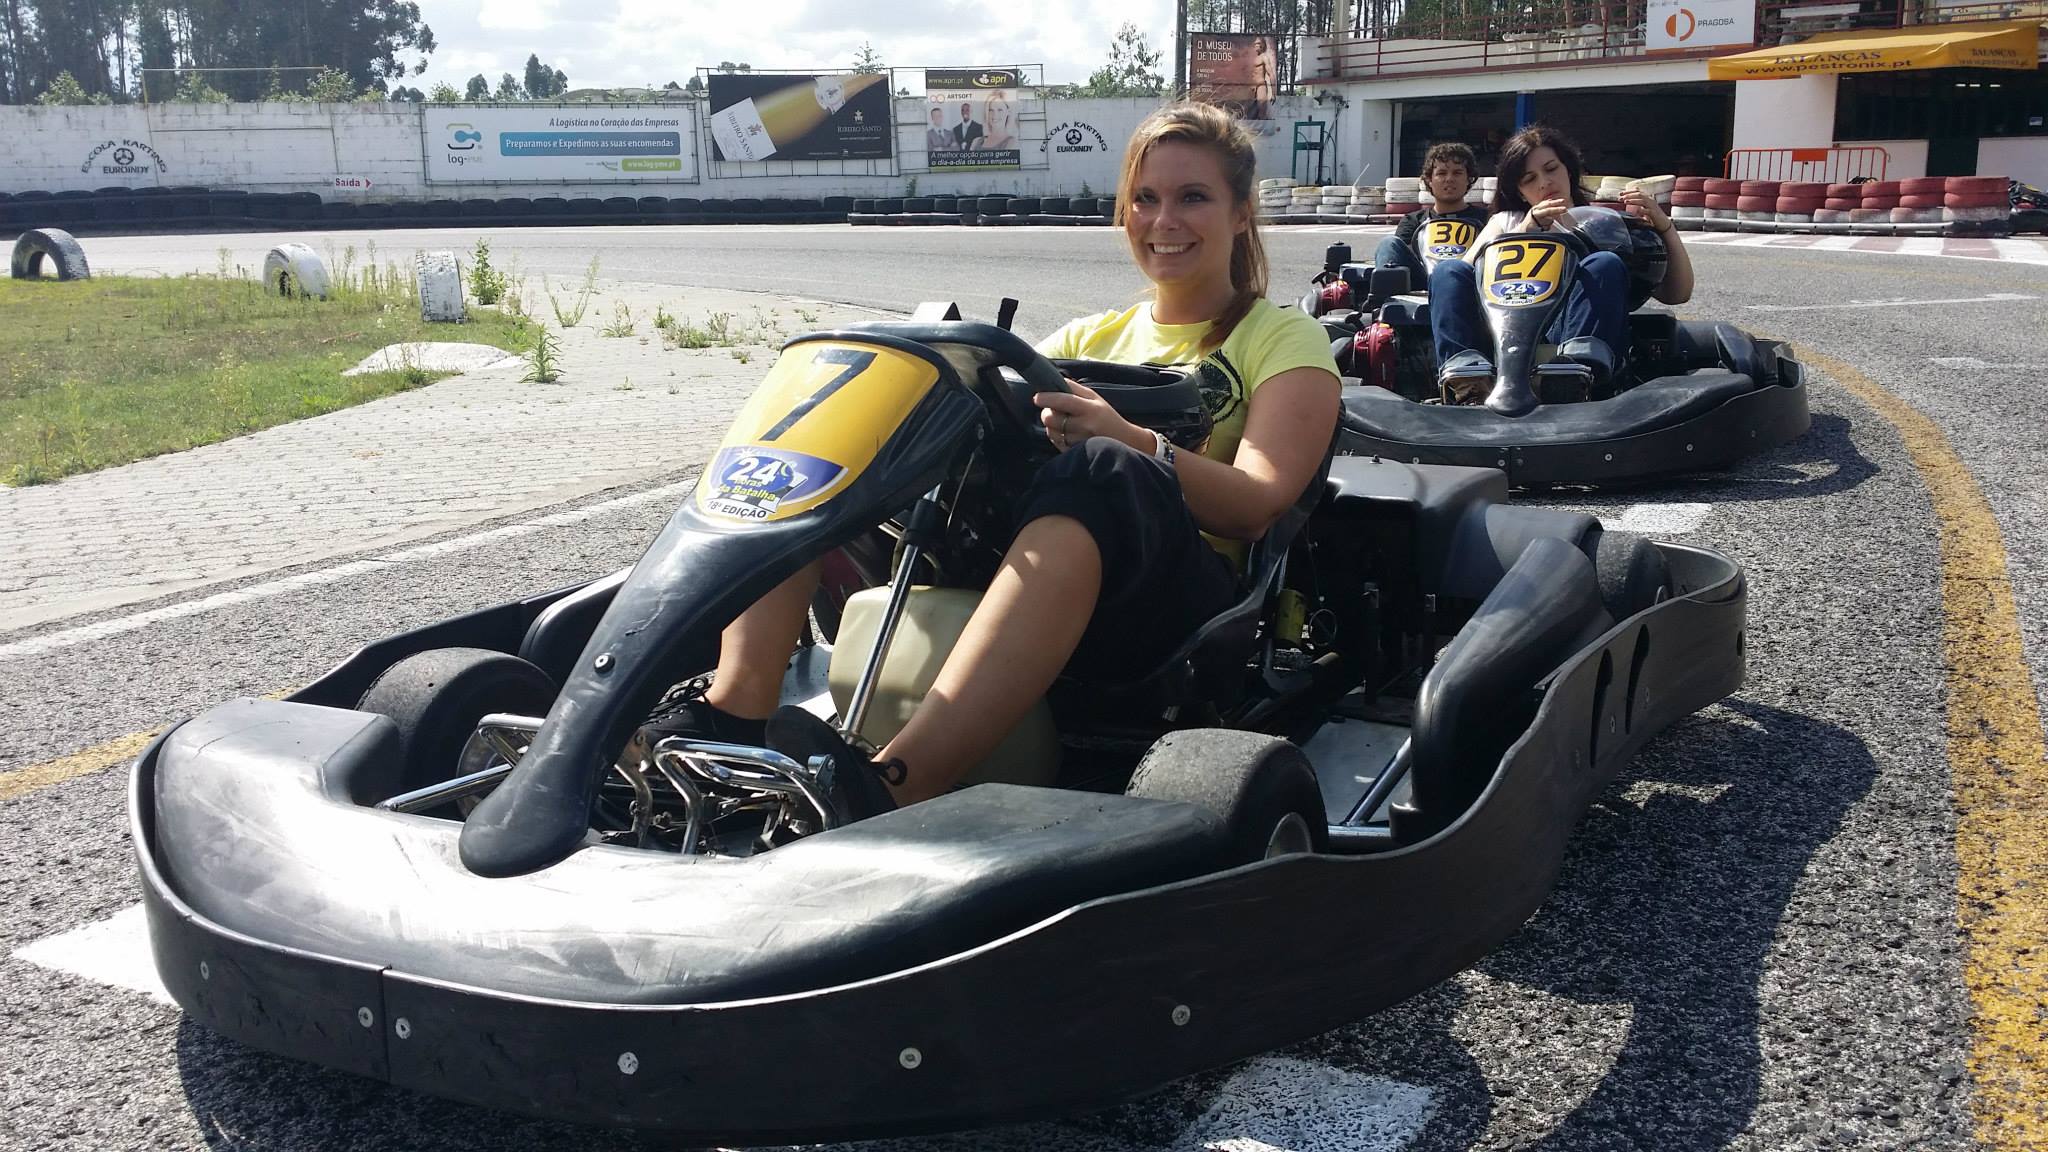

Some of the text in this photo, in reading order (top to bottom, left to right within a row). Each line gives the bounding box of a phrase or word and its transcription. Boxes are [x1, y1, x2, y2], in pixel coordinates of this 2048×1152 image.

[1697, 18, 1735, 27] PRAGOSA
[1197, 40, 1232, 50] O MUSEU
[1197, 51, 1233, 61] DE TODOS
[1745, 60, 1912, 75] www.pestronix.pt
[990, 74, 1007, 85] apri
[549, 118, 555, 127] A
[589, 119, 600, 127] no
[601, 118, 630, 128] Coração
[631, 118, 643, 127] das
[645, 118, 679, 128] Empresas
[1040, 121, 1108, 153] ESOLA KARTING
[506, 139, 552, 150] Preparamos
[559, 138, 600, 150] Expedimos
[627, 138, 674, 148] encomendas
[1056, 145, 1093, 153] EUROINDY
[81, 139, 167, 174] ESCOLA KARTING
[931, 150, 1011, 160] A melhor opção para gerir
[990, 158, 1018, 166] empresa
[103, 165, 149, 174] EUROINDY
[1434, 223, 1471, 246] 30
[1495, 243, 1557, 282] 27
[1503, 282, 1528, 294] 24
[758, 348, 879, 442] 7
[727, 456, 783, 486] 24
[732, 485, 777, 502] Batalha
[721, 504, 768, 519] EDIÇÃO
